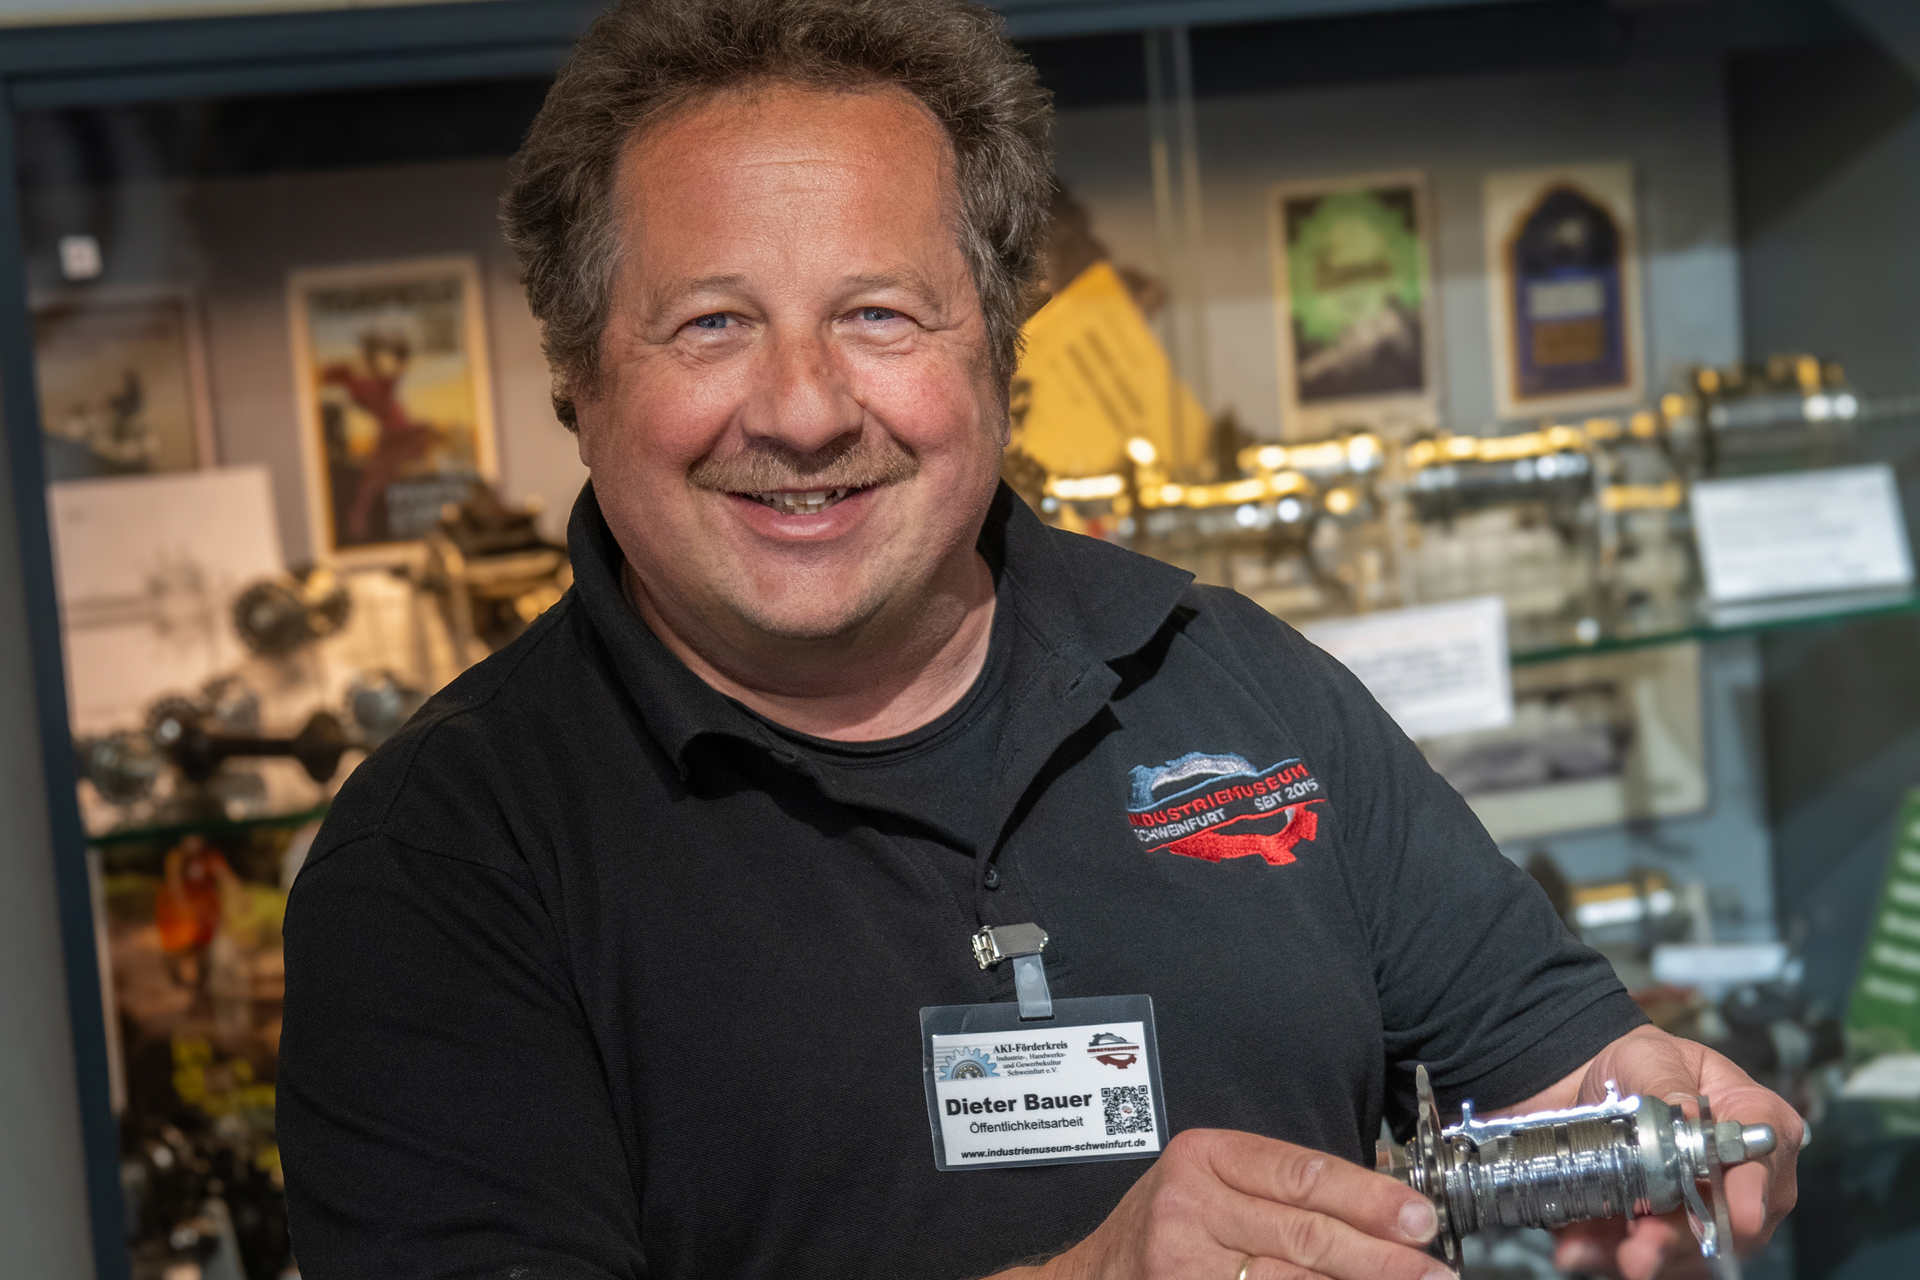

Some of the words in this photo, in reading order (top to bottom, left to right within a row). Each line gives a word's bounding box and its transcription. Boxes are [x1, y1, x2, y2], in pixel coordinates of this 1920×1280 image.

[1254, 792, 1282, 811] SEIT
[1287, 778, 1319, 800] 2015
[993, 1041, 1068, 1054] AKI-Förderkreis
[1029, 1052, 1066, 1060] Handwerks-
[1016, 1060, 1061, 1068] Gewerbekultur
[1007, 1069, 1044, 1077] Schweinfurt
[945, 1098, 1017, 1116] Dieter
[1023, 1093, 1093, 1111] Bauer
[969, 1116, 1084, 1134] Öffentlichkeitsarbeit
[961, 1139, 1146, 1159] www.industriemuseum-schweinfurt.de
